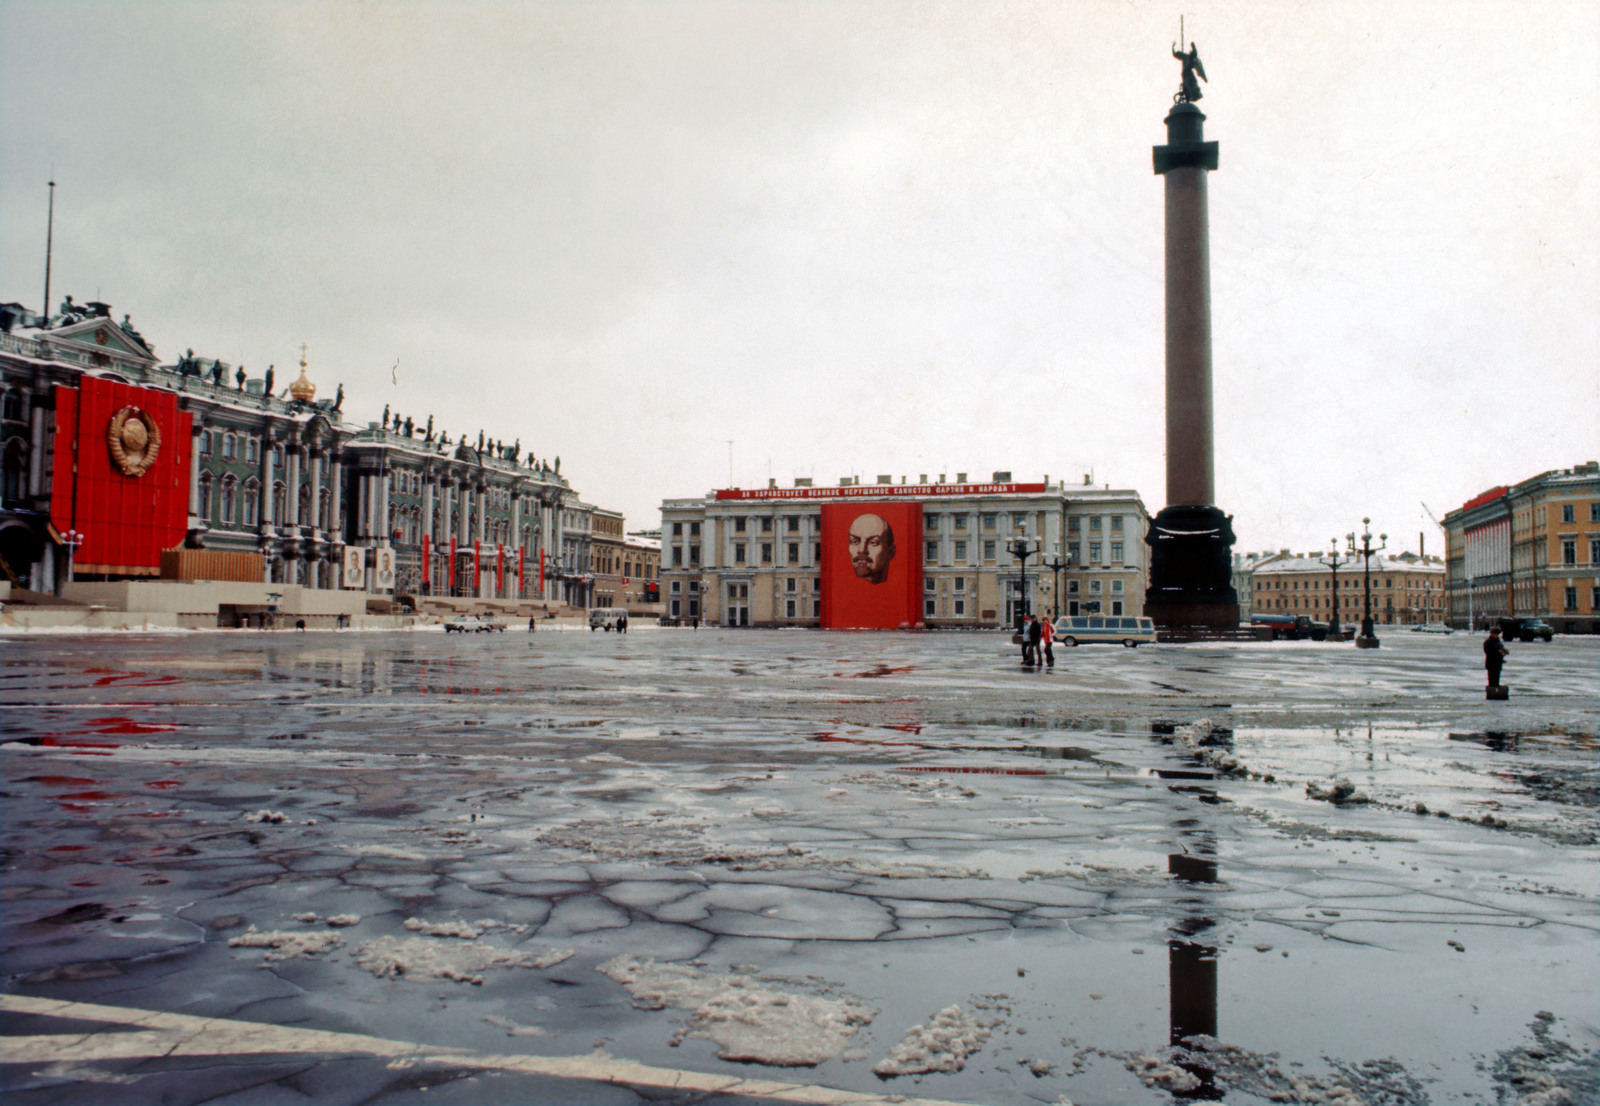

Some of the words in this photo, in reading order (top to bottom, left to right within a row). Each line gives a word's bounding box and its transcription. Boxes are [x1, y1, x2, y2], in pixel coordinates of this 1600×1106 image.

[755, 490, 803, 498] ЗДРАВСТВУЕТ
[808, 489, 840, 497] ВЕЛИКОЕ
[894, 487, 931, 495] ЕДИНСТВО
